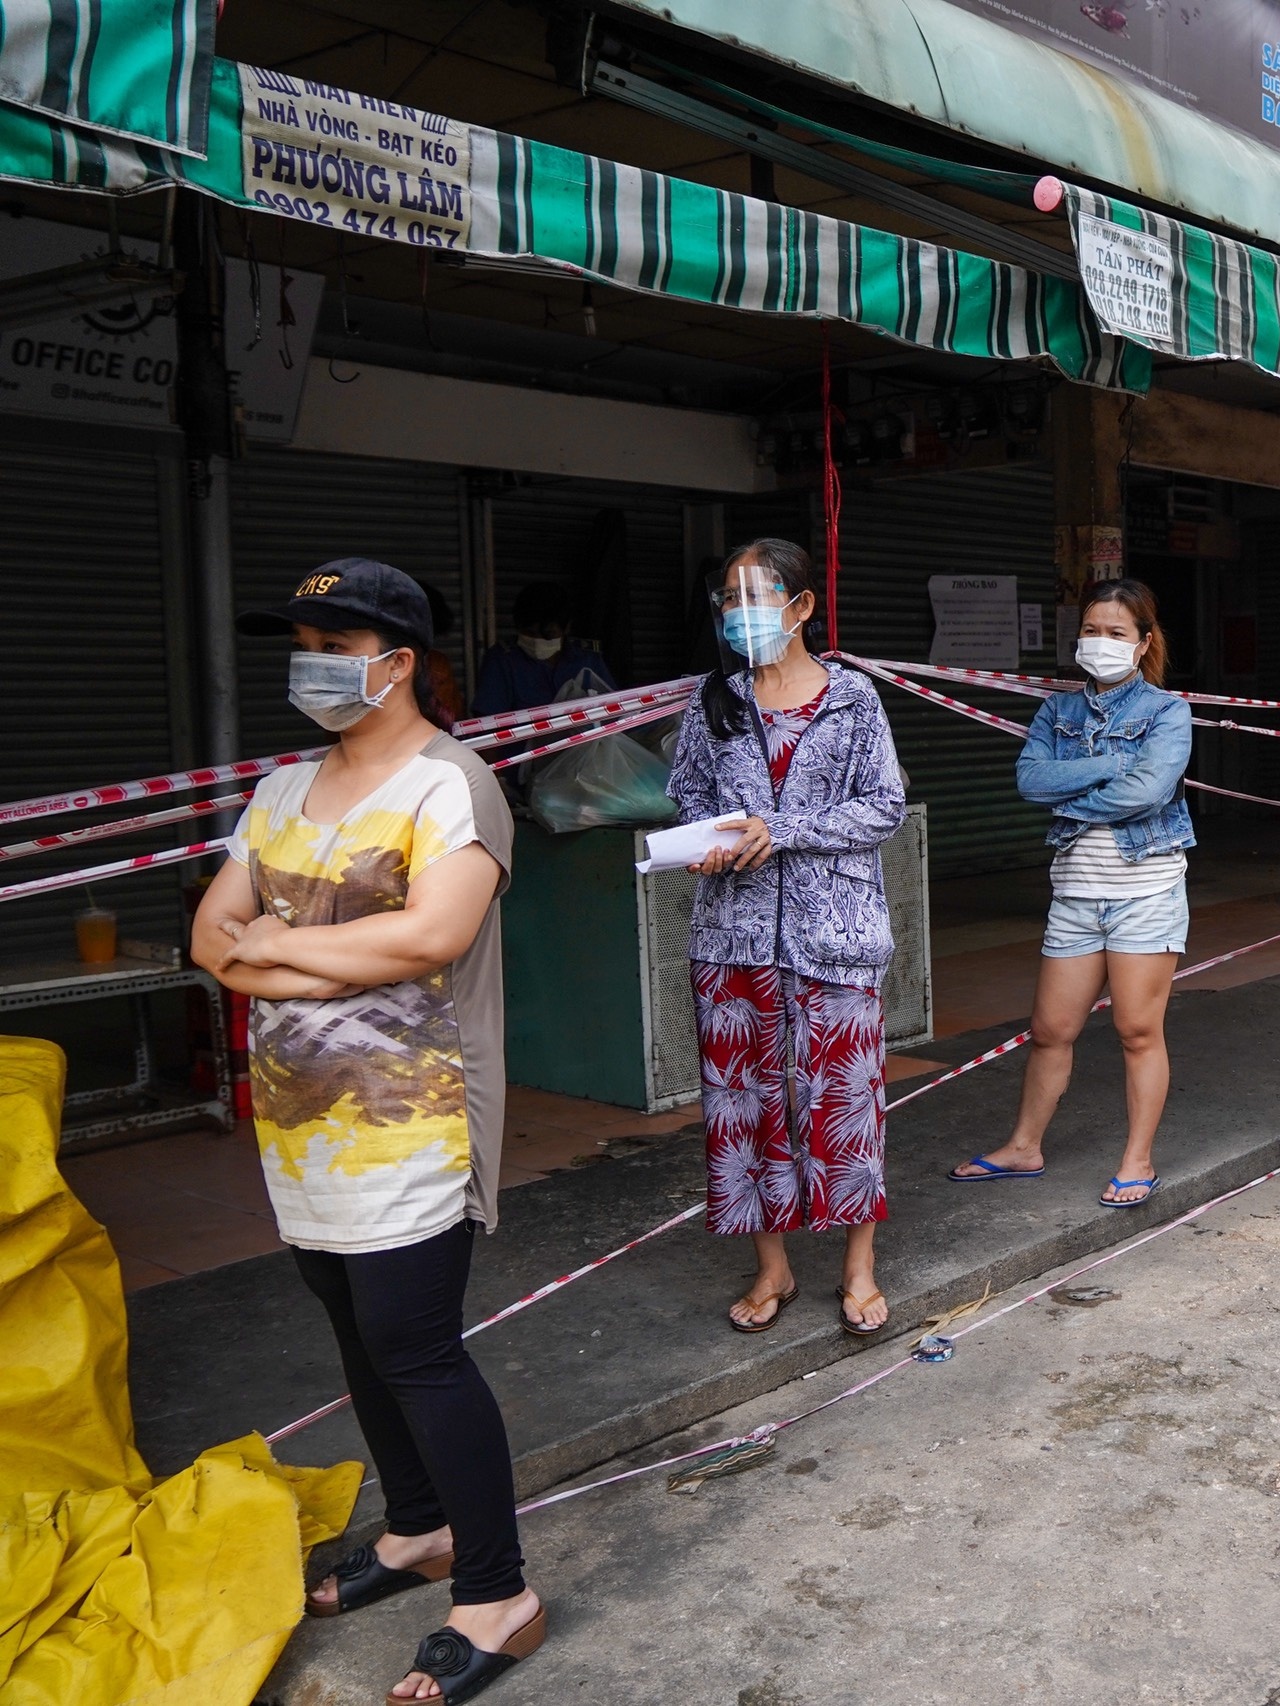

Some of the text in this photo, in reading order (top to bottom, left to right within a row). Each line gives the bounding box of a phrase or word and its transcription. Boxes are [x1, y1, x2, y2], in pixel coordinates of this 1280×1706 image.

[258, 98, 300, 128] NHÀ
[306, 109, 359, 143] VÒNG
[378, 129, 414, 158] BẠT
[421, 139, 457, 167] KÉO
[251, 136, 464, 222] PHƯƠNG LÂM
[255, 189, 460, 249] 0902 474 057
[1127, 257, 1164, 281] PHÁT
[12, 337, 124, 380] OFFICE
[13, 803, 49, 818] ALLOWED
[48, 801, 69, 811] AREA
